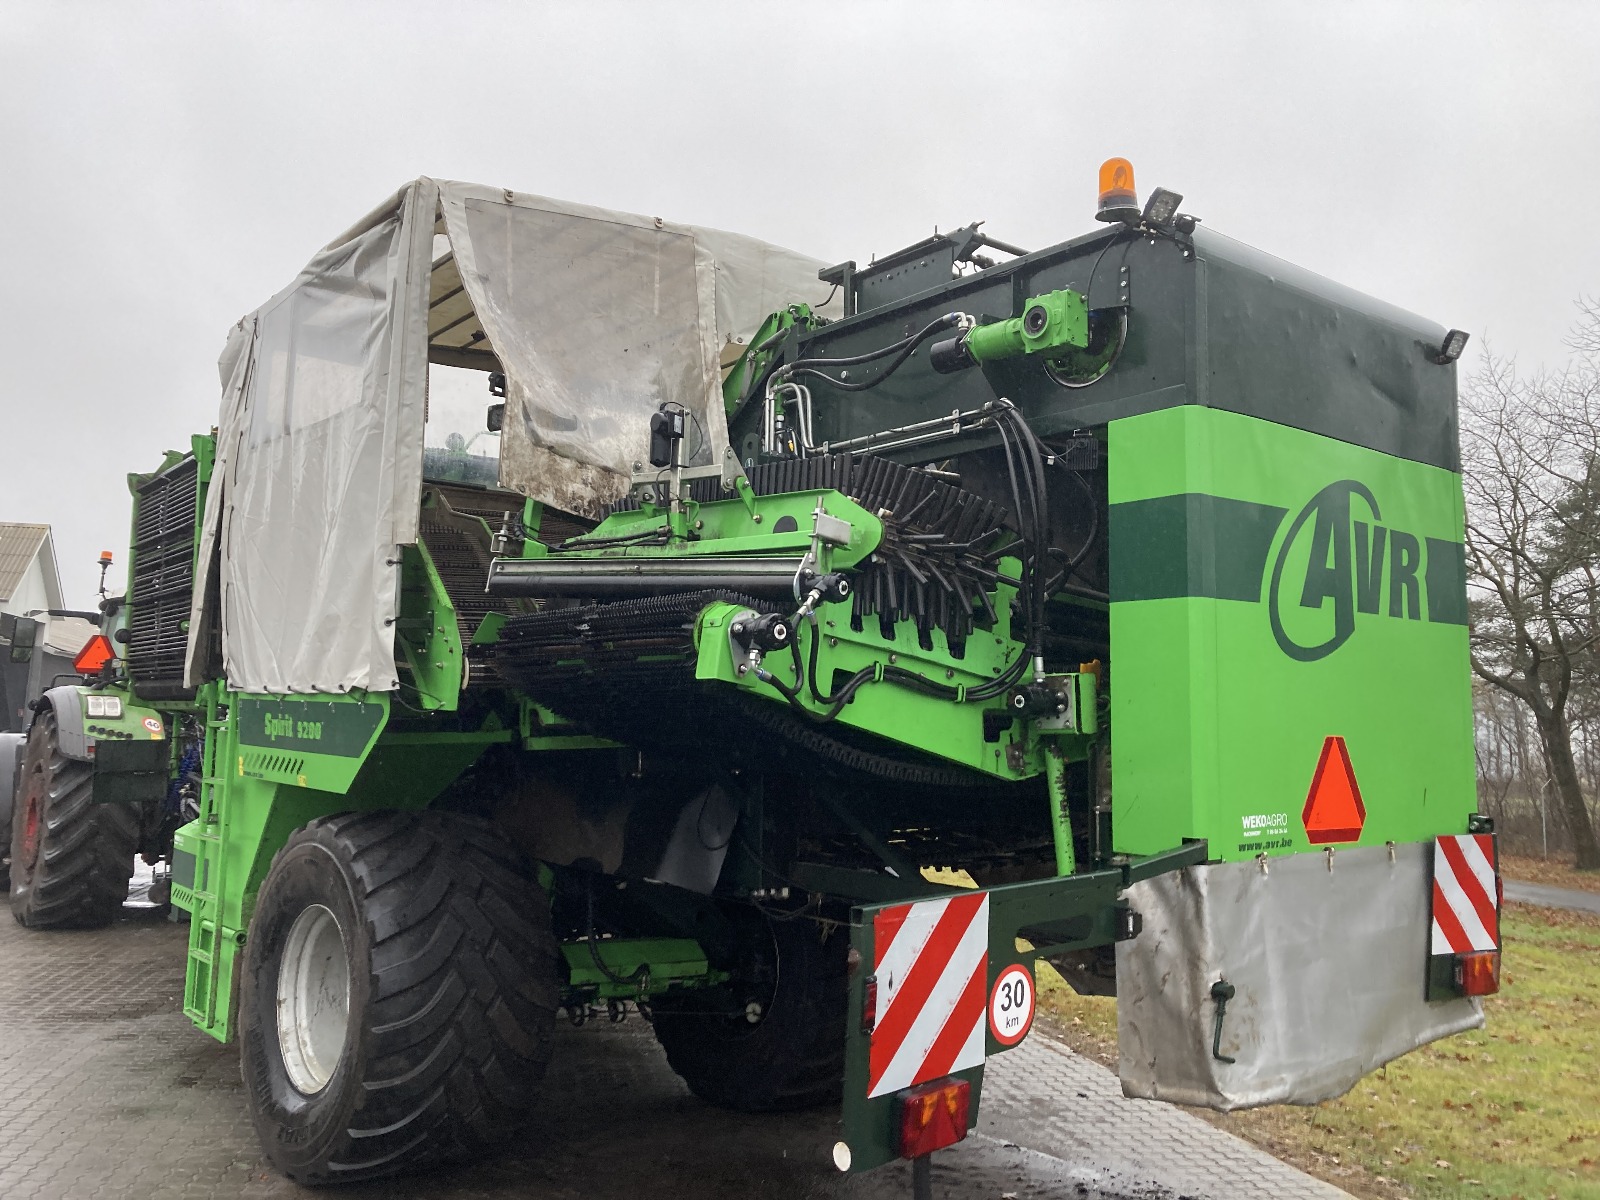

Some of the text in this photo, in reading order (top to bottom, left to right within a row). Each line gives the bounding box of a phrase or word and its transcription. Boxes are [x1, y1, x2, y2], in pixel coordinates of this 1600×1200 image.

[1269, 479, 1422, 662] AVR
[146, 720, 160, 729] 40
[264, 712, 293, 741] Spirit
[1241, 813, 1288, 829] WEKOAGRO
[1238, 837, 1293, 852] www.avr.be
[1000, 978, 1025, 1012] 30
[1005, 1016, 1019, 1029] km
